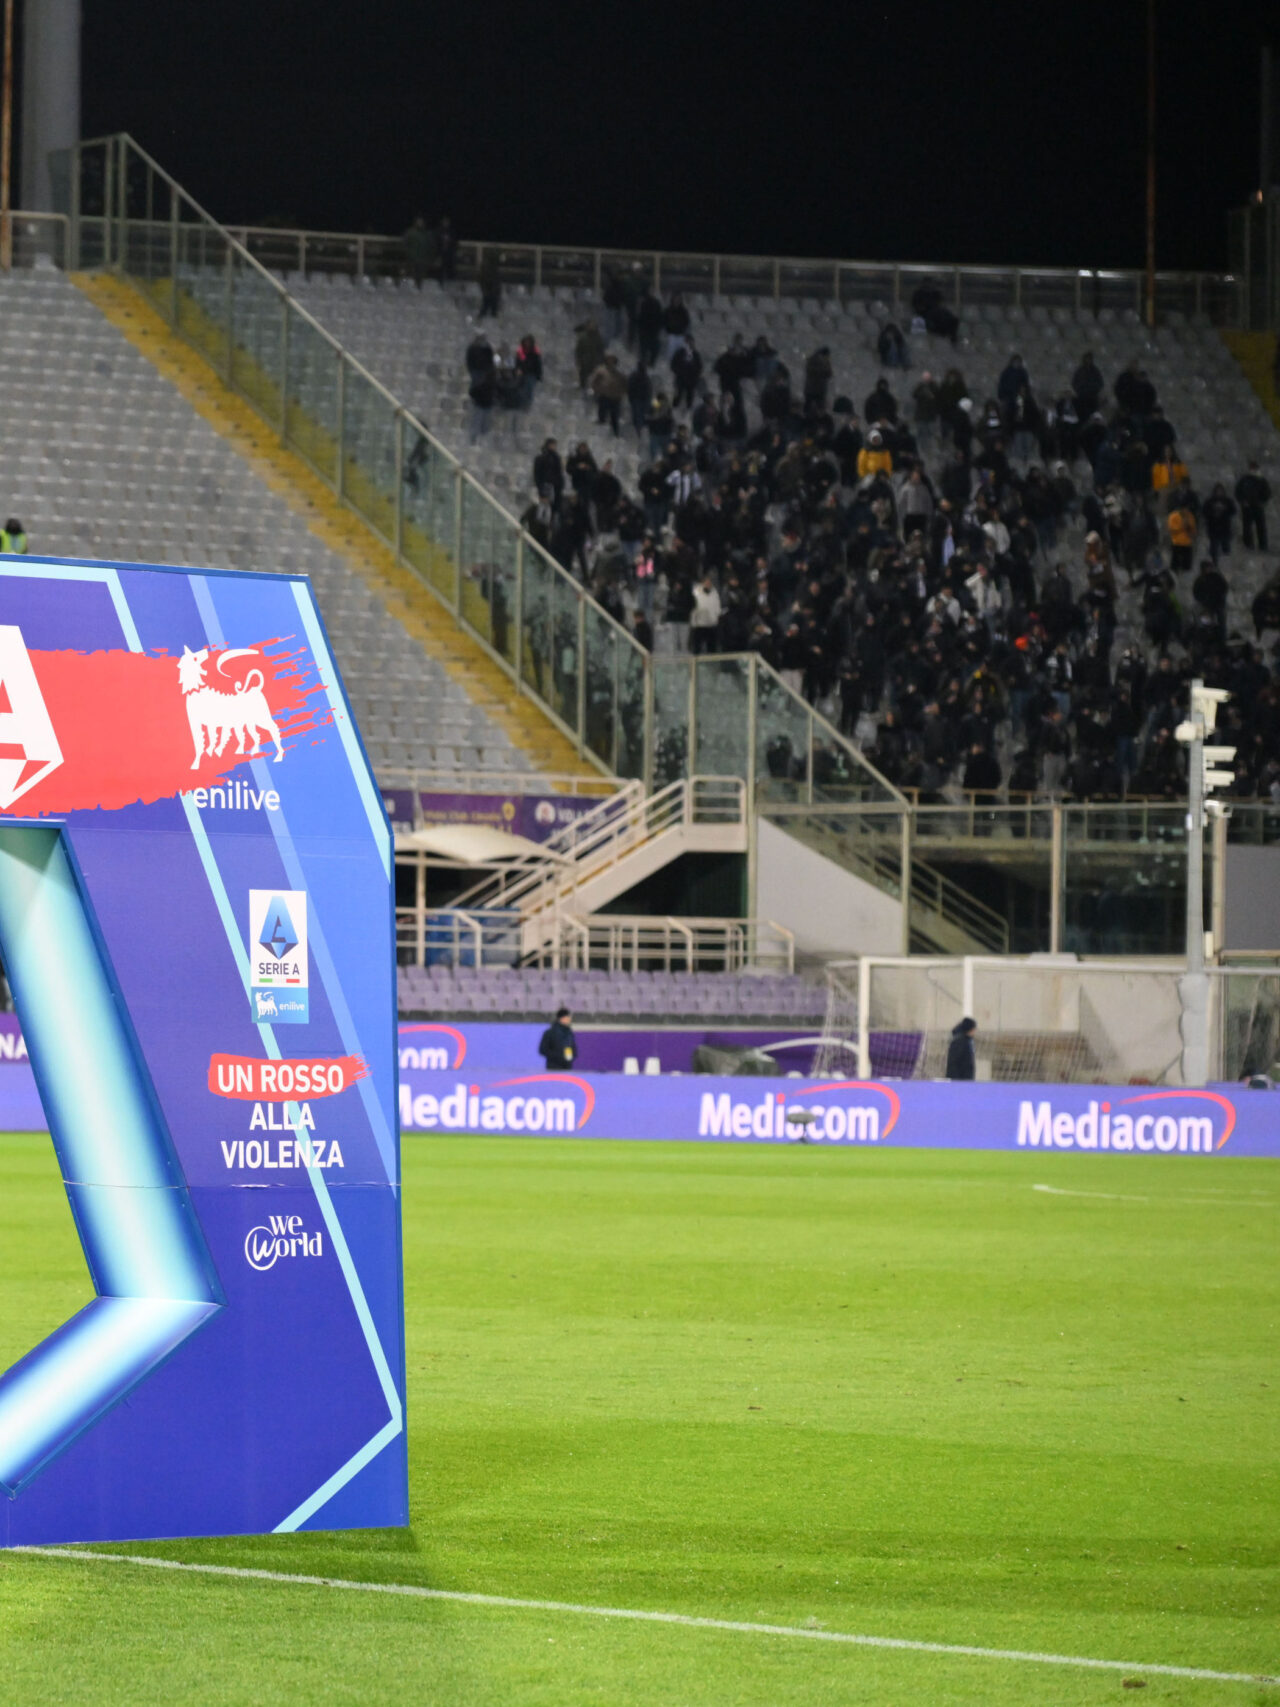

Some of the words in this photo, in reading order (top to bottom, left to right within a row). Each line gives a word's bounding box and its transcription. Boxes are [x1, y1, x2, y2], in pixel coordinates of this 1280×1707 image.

[193, 780, 280, 810] enilive
[258, 962, 289, 975] SERIE
[292, 963, 300, 975] A
[279, 1001, 305, 1011] enilive
[217, 1064, 253, 1092] UN
[260, 1064, 344, 1093] ROSSO
[249, 1103, 316, 1130] ALLA
[1018, 1101, 1213, 1152] Mediacom
[220, 1140, 344, 1169] VIOLENZA
